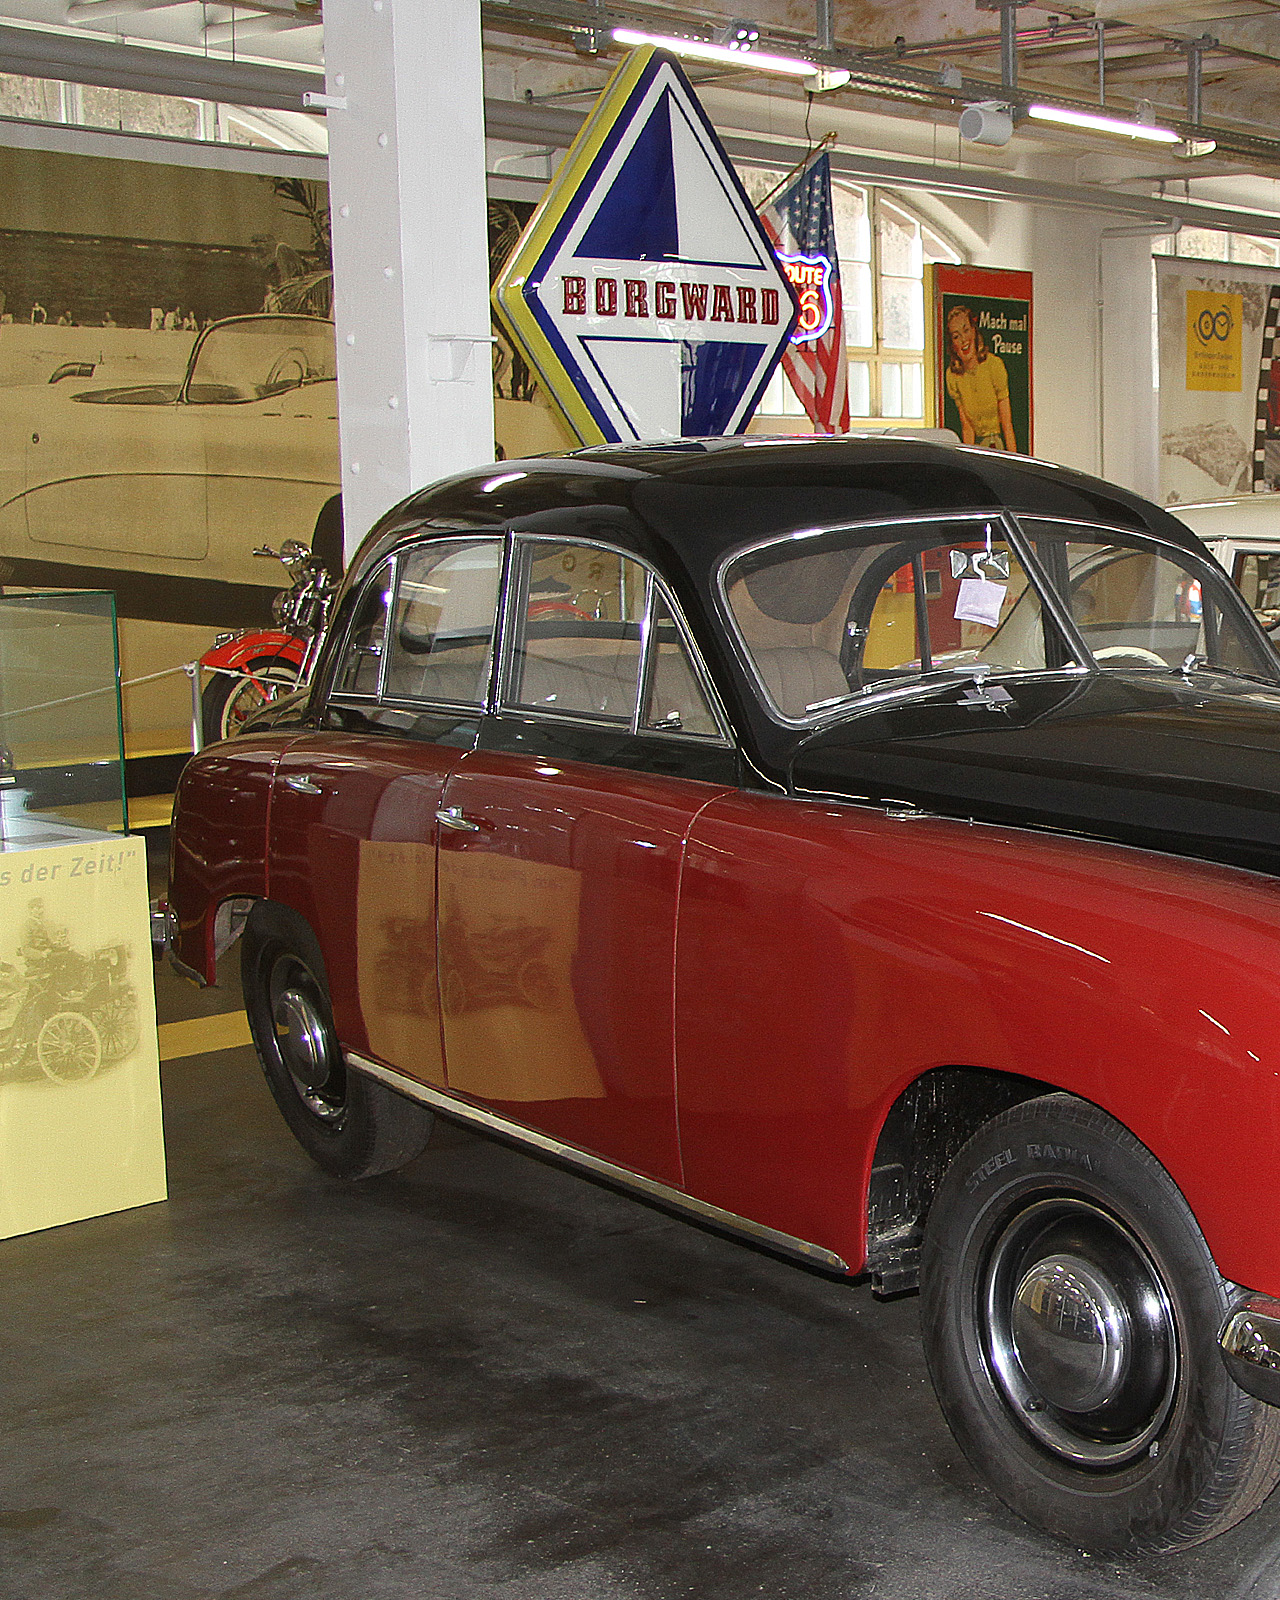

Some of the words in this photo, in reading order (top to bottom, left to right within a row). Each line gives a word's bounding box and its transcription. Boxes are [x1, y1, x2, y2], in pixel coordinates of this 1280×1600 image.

[561, 275, 779, 325] BORGWARD
[978, 311, 1007, 330] Mach
[1009, 314, 1028, 331] mal
[991, 333, 1023, 354] Pause
[20, 863, 62, 883] der
[965, 1149, 1017, 1194] STEEL
